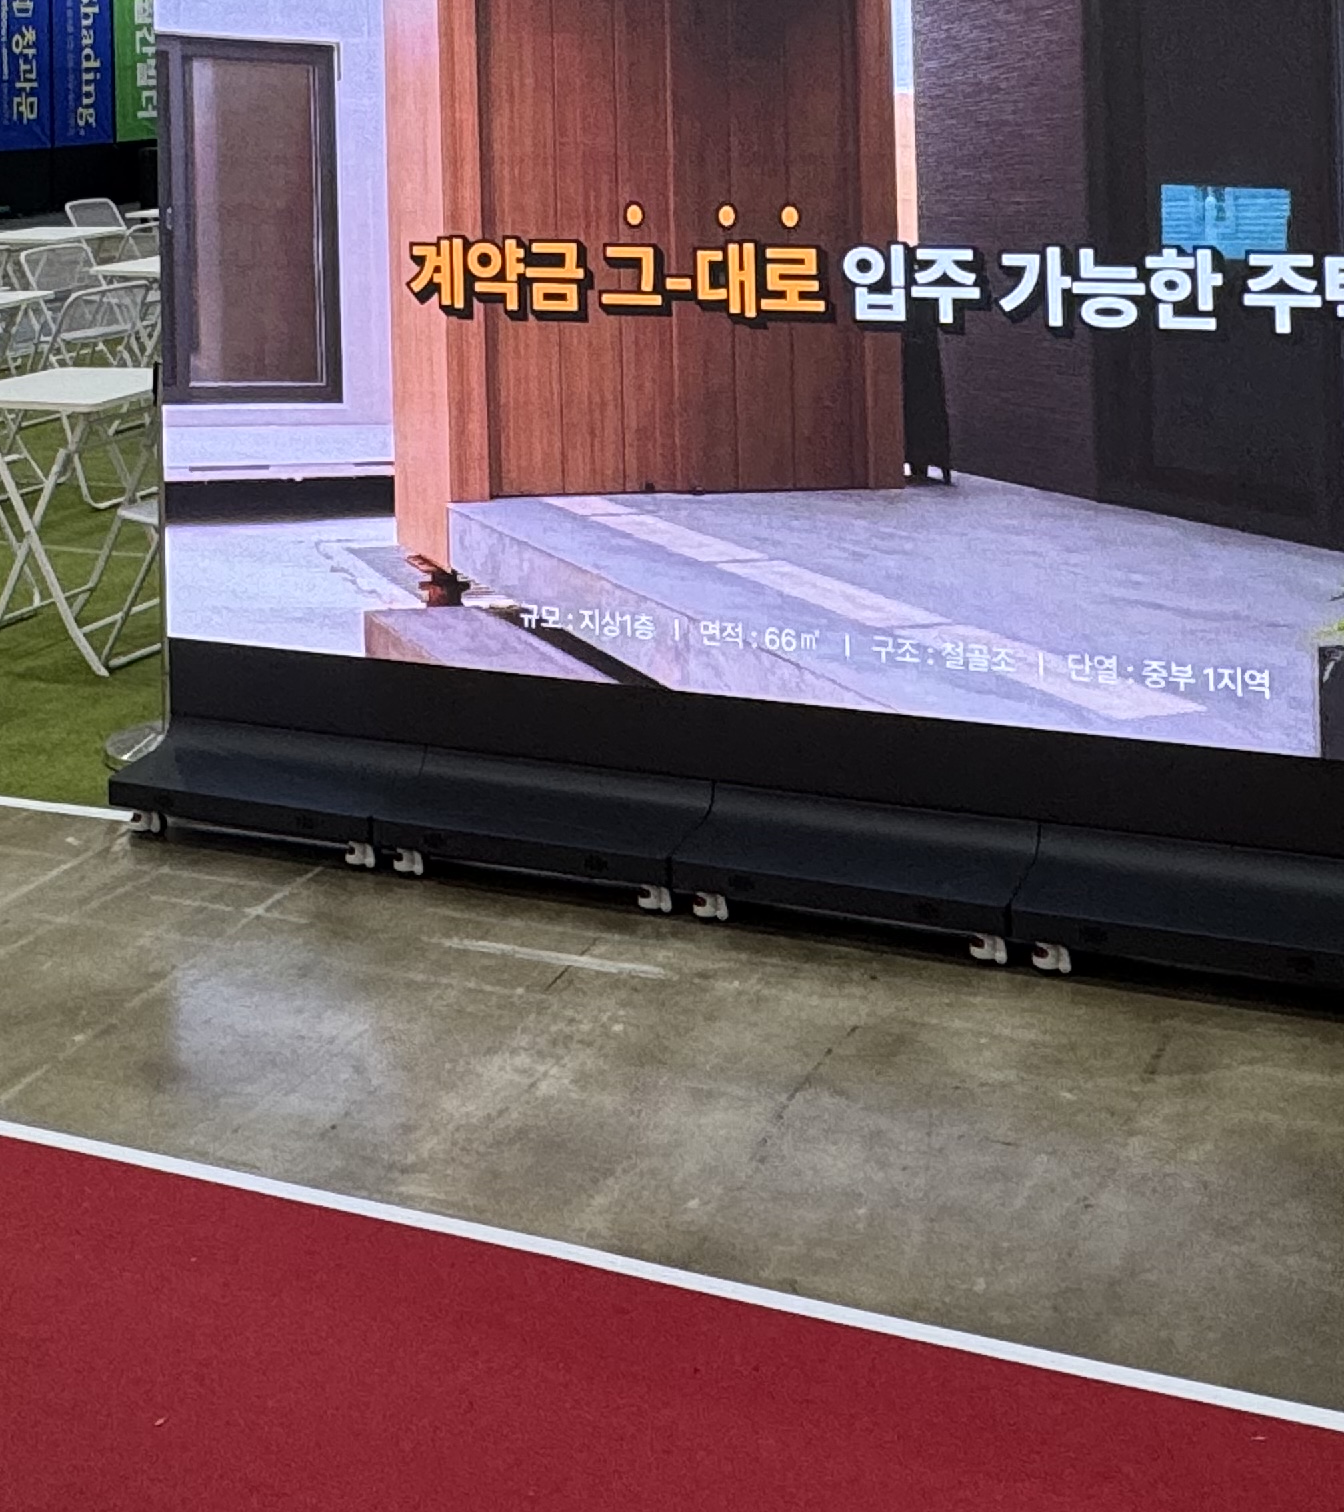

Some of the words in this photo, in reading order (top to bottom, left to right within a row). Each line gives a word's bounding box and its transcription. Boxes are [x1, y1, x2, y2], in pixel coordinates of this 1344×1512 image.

[12, 24, 39, 125] 창과문
[409, 238, 586, 312] 계약금
[600, 242, 827, 319] 그-대로
[842, 244, 982, 325] 입주
[1000, 246, 1224, 332] 가능한
